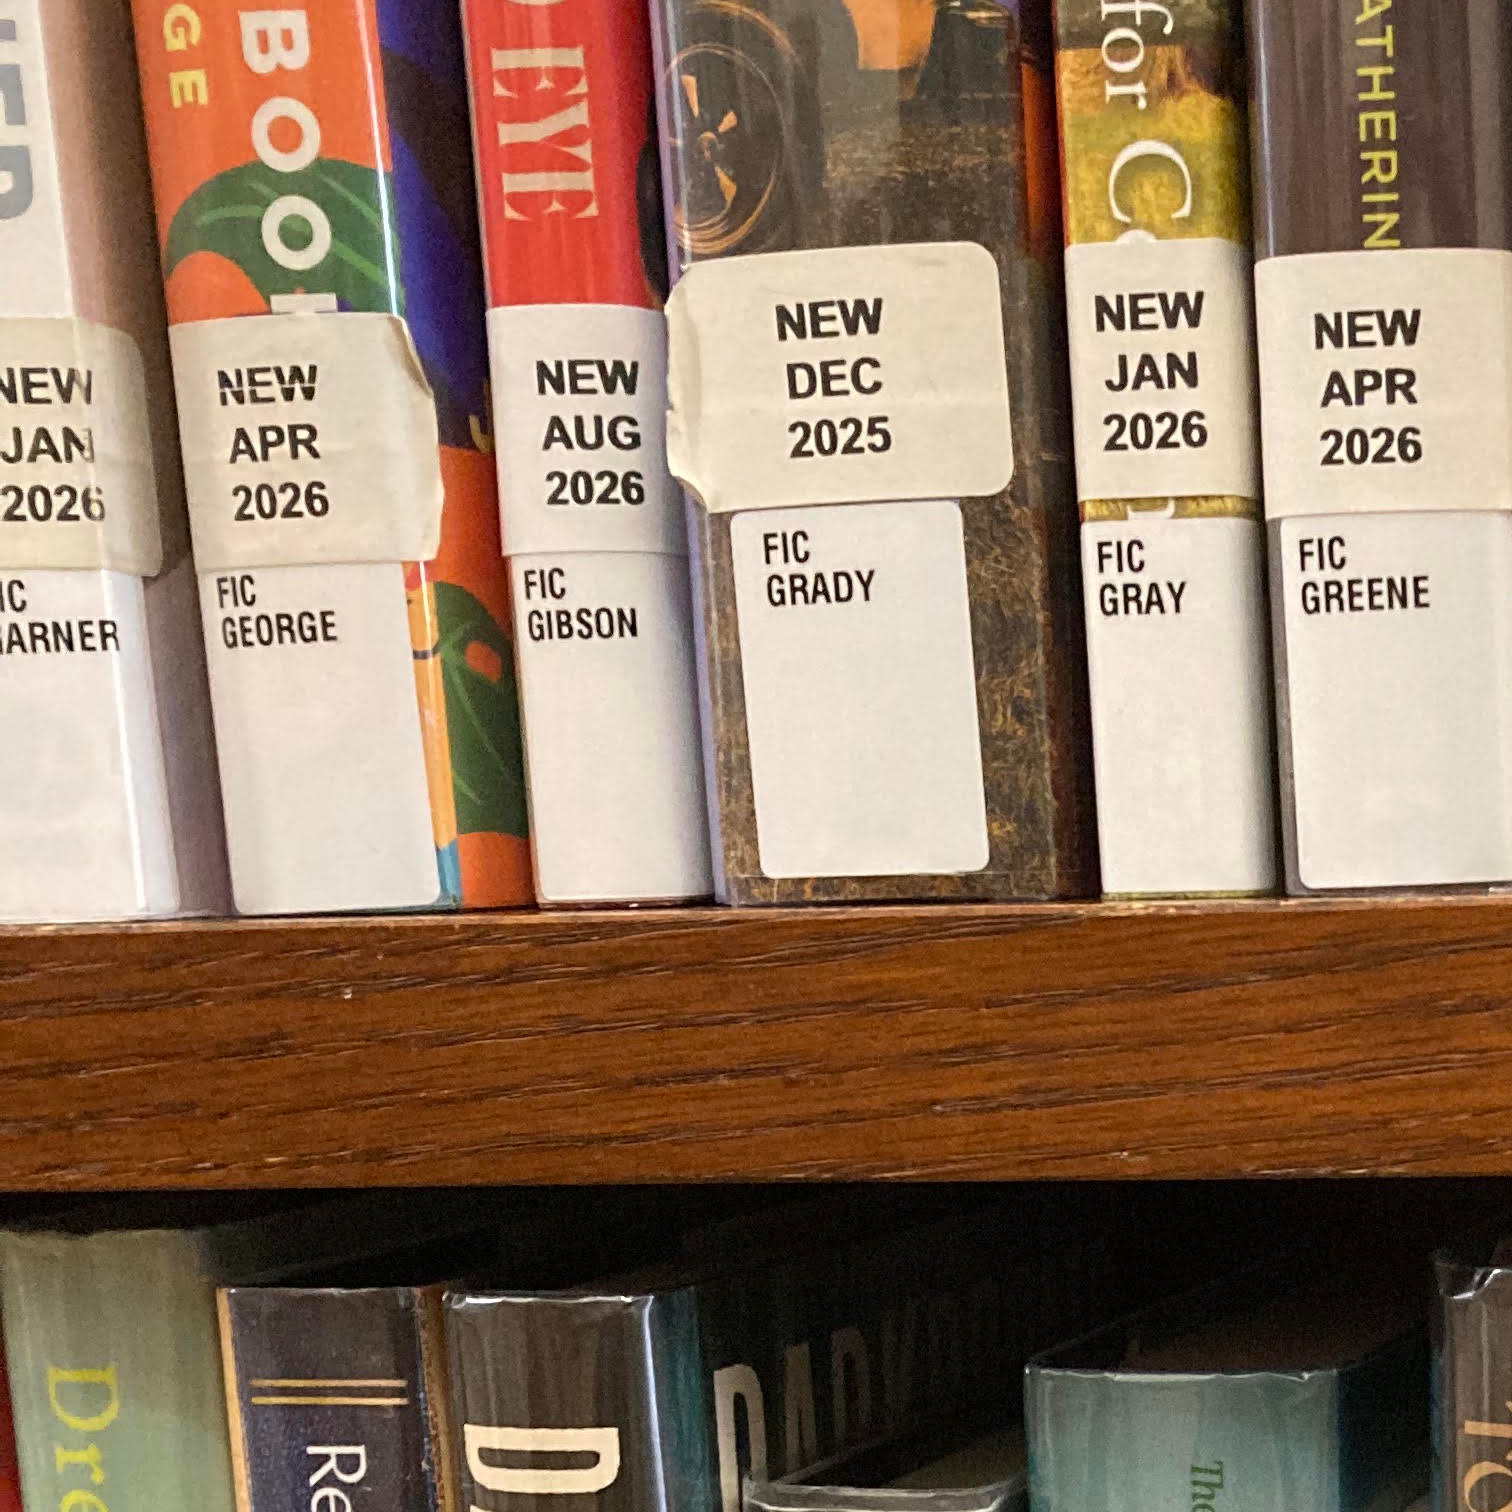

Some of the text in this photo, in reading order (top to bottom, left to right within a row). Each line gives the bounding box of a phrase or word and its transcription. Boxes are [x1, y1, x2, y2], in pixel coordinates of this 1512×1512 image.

[491, 46, 599, 221] EYE
[1101, 0, 1192, 243] for C
[238, 9, 337, 312] BOO
[775, 297, 883, 342] NEW
[1095, 291, 1204, 332] NEW
[1314, 309, 1421, 350] NEW
[217, 364, 318, 406] NEW
[536, 359, 640, 396] NEW
[786, 357, 883, 400] DEC
[1104, 351, 1199, 393] JAN
[1320, 368, 1418, 408] APR
[0, 426, 94, 463] JAN
[228, 423, 321, 464] APR
[541, 413, 642, 452] AUG
[788, 416, 893, 459] 2025
[1102, 411, 1209, 452] 2026
[1320, 427, 1423, 466] 2026
[1, 484, 106, 522] 2026
[232, 481, 330, 521] 2026
[545, 470, 645, 506] 2026
[762, 530, 811, 565] FIC
[1097, 539, 1145, 573] FIC
[1299, 536, 1346, 571] FIC
[0, 578, 27, 613] IC
[216, 574, 257, 610] FIC
[523, 567, 566, 601] FIC
[766, 569, 876, 607] GRADY
[1099, 581, 1187, 616] GRAY
[1301, 575, 1431, 615] GREENE
[0, 619, 120, 654] ARNER
[221, 609, 338, 650] GEORGE
[527, 608, 639, 642] GIBSON
